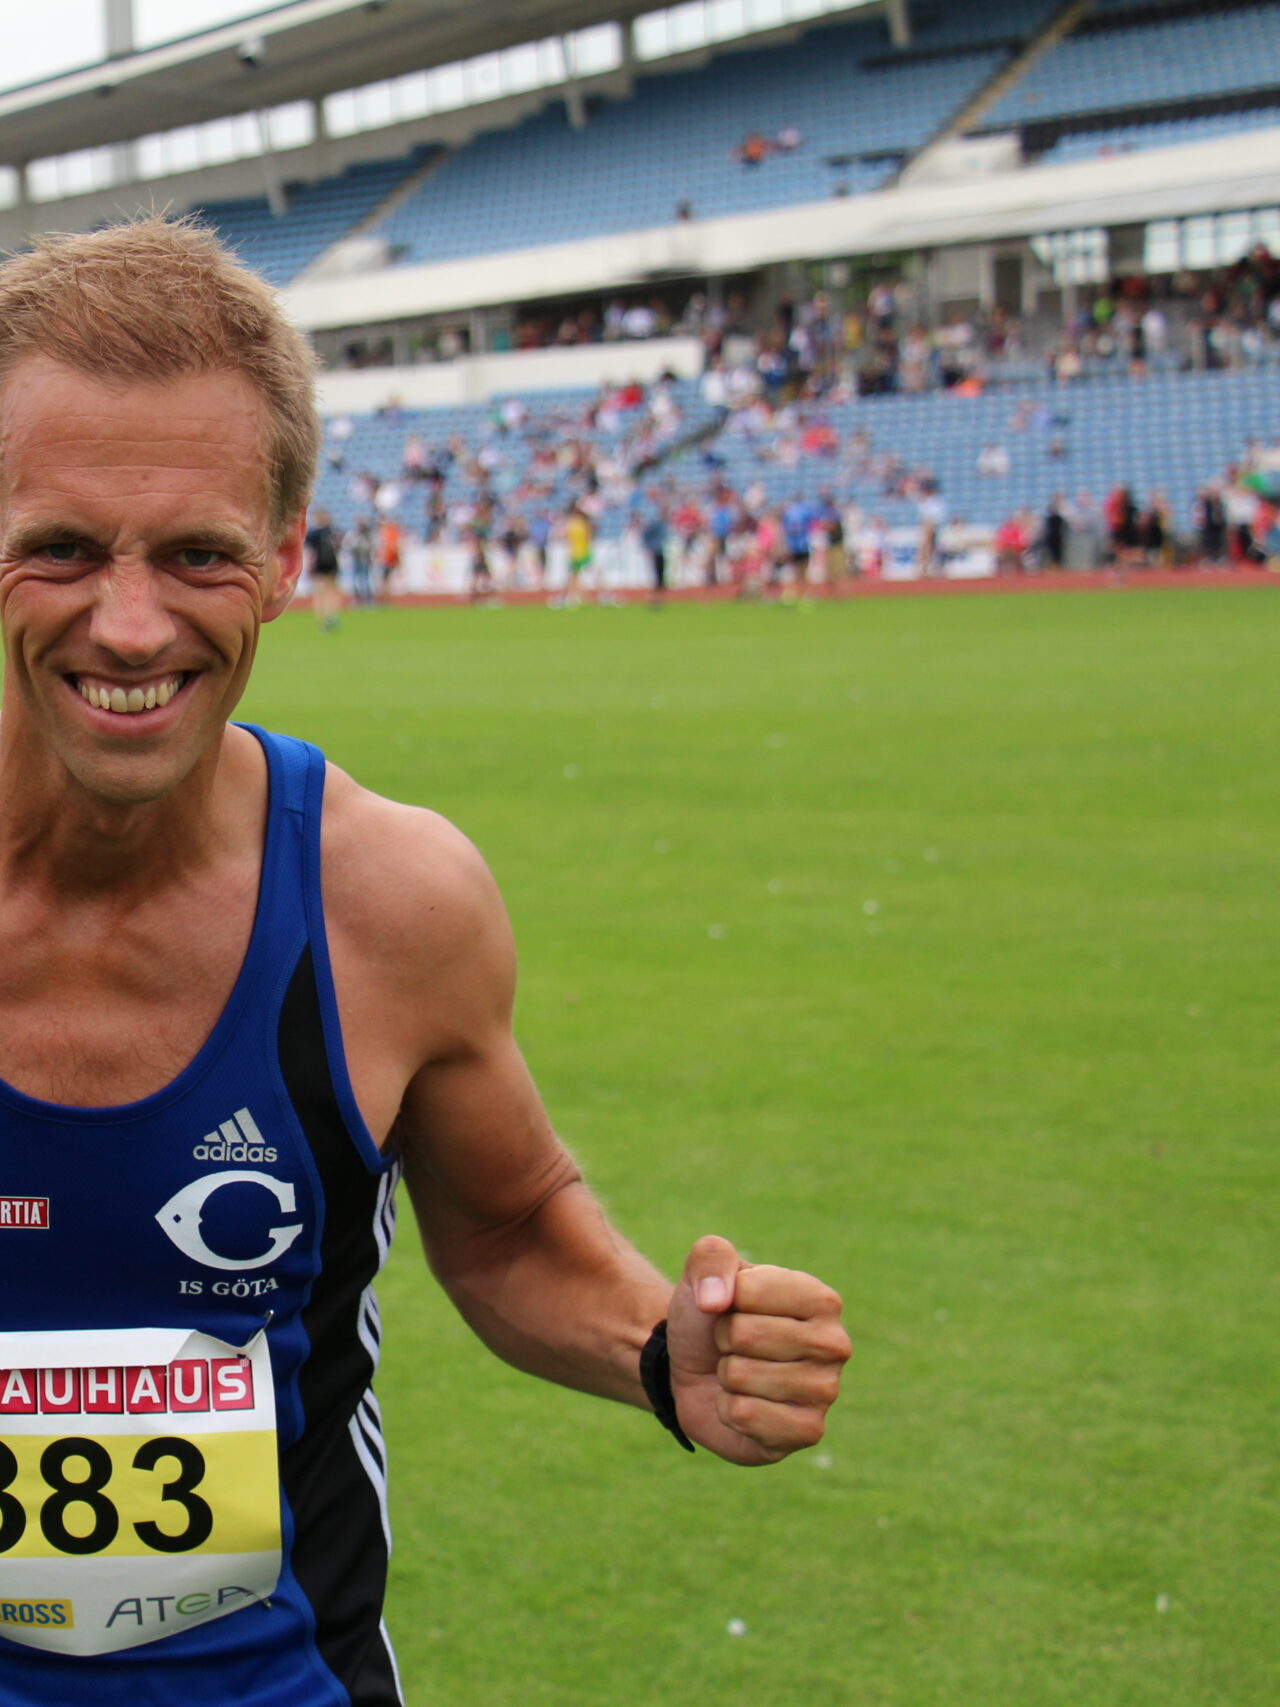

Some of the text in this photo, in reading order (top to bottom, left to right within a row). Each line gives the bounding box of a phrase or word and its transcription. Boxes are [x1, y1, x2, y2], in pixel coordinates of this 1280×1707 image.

[193, 1141, 277, 1163] adidas
[179, 1277, 279, 1297] IS GÖTA
